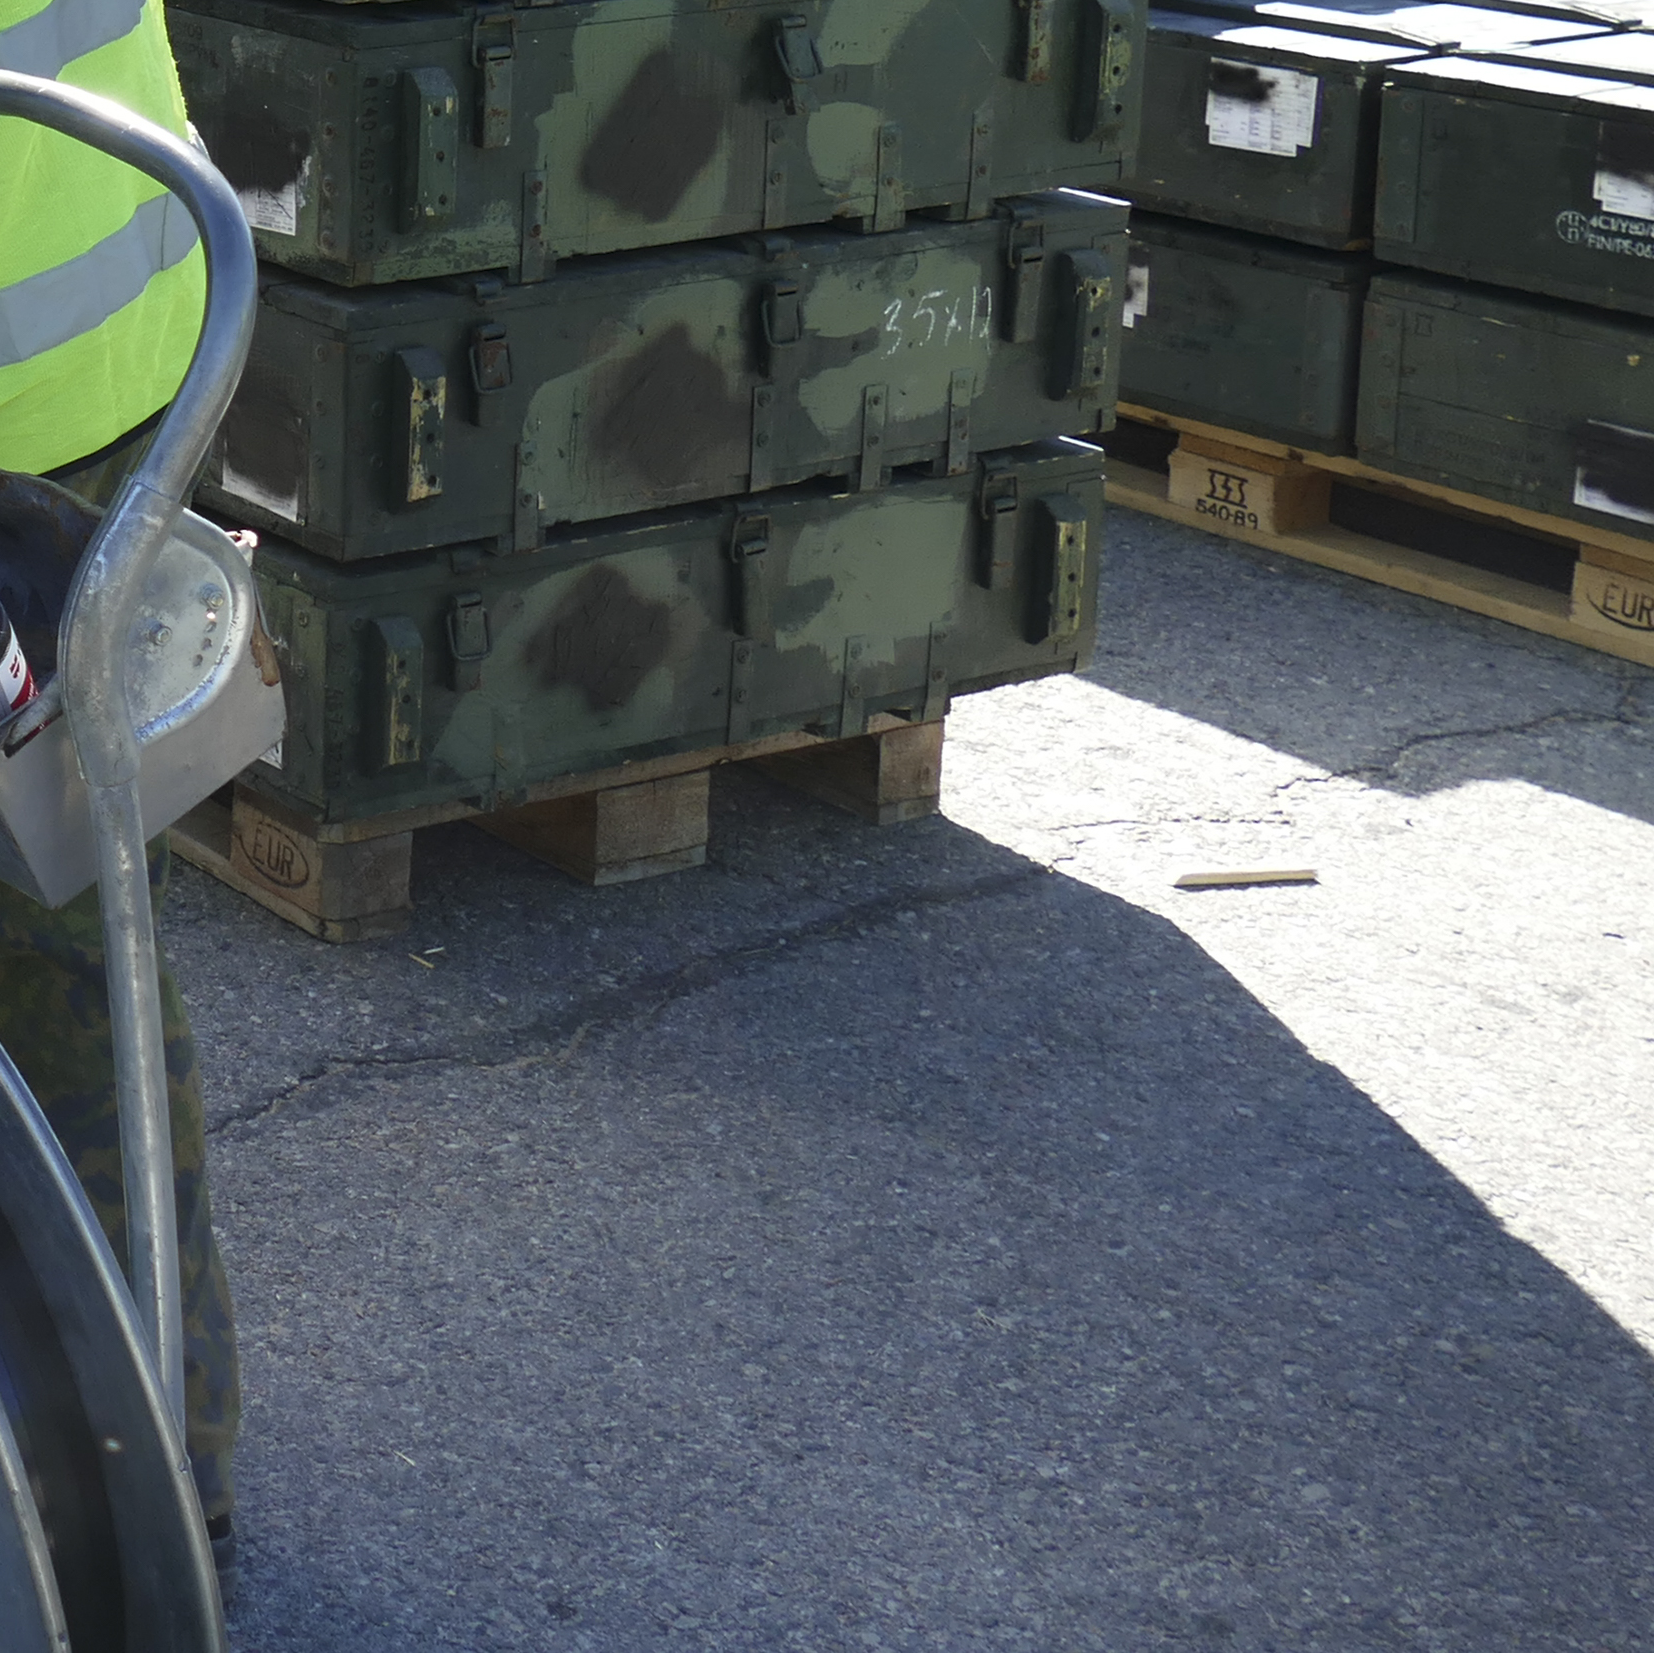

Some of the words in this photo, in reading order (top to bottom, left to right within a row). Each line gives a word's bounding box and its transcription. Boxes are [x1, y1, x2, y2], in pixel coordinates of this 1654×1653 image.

[1195, 498, 1259, 530] 540-89
[1602, 582, 1654, 628] EUR
[253, 827, 294, 881] EUR
